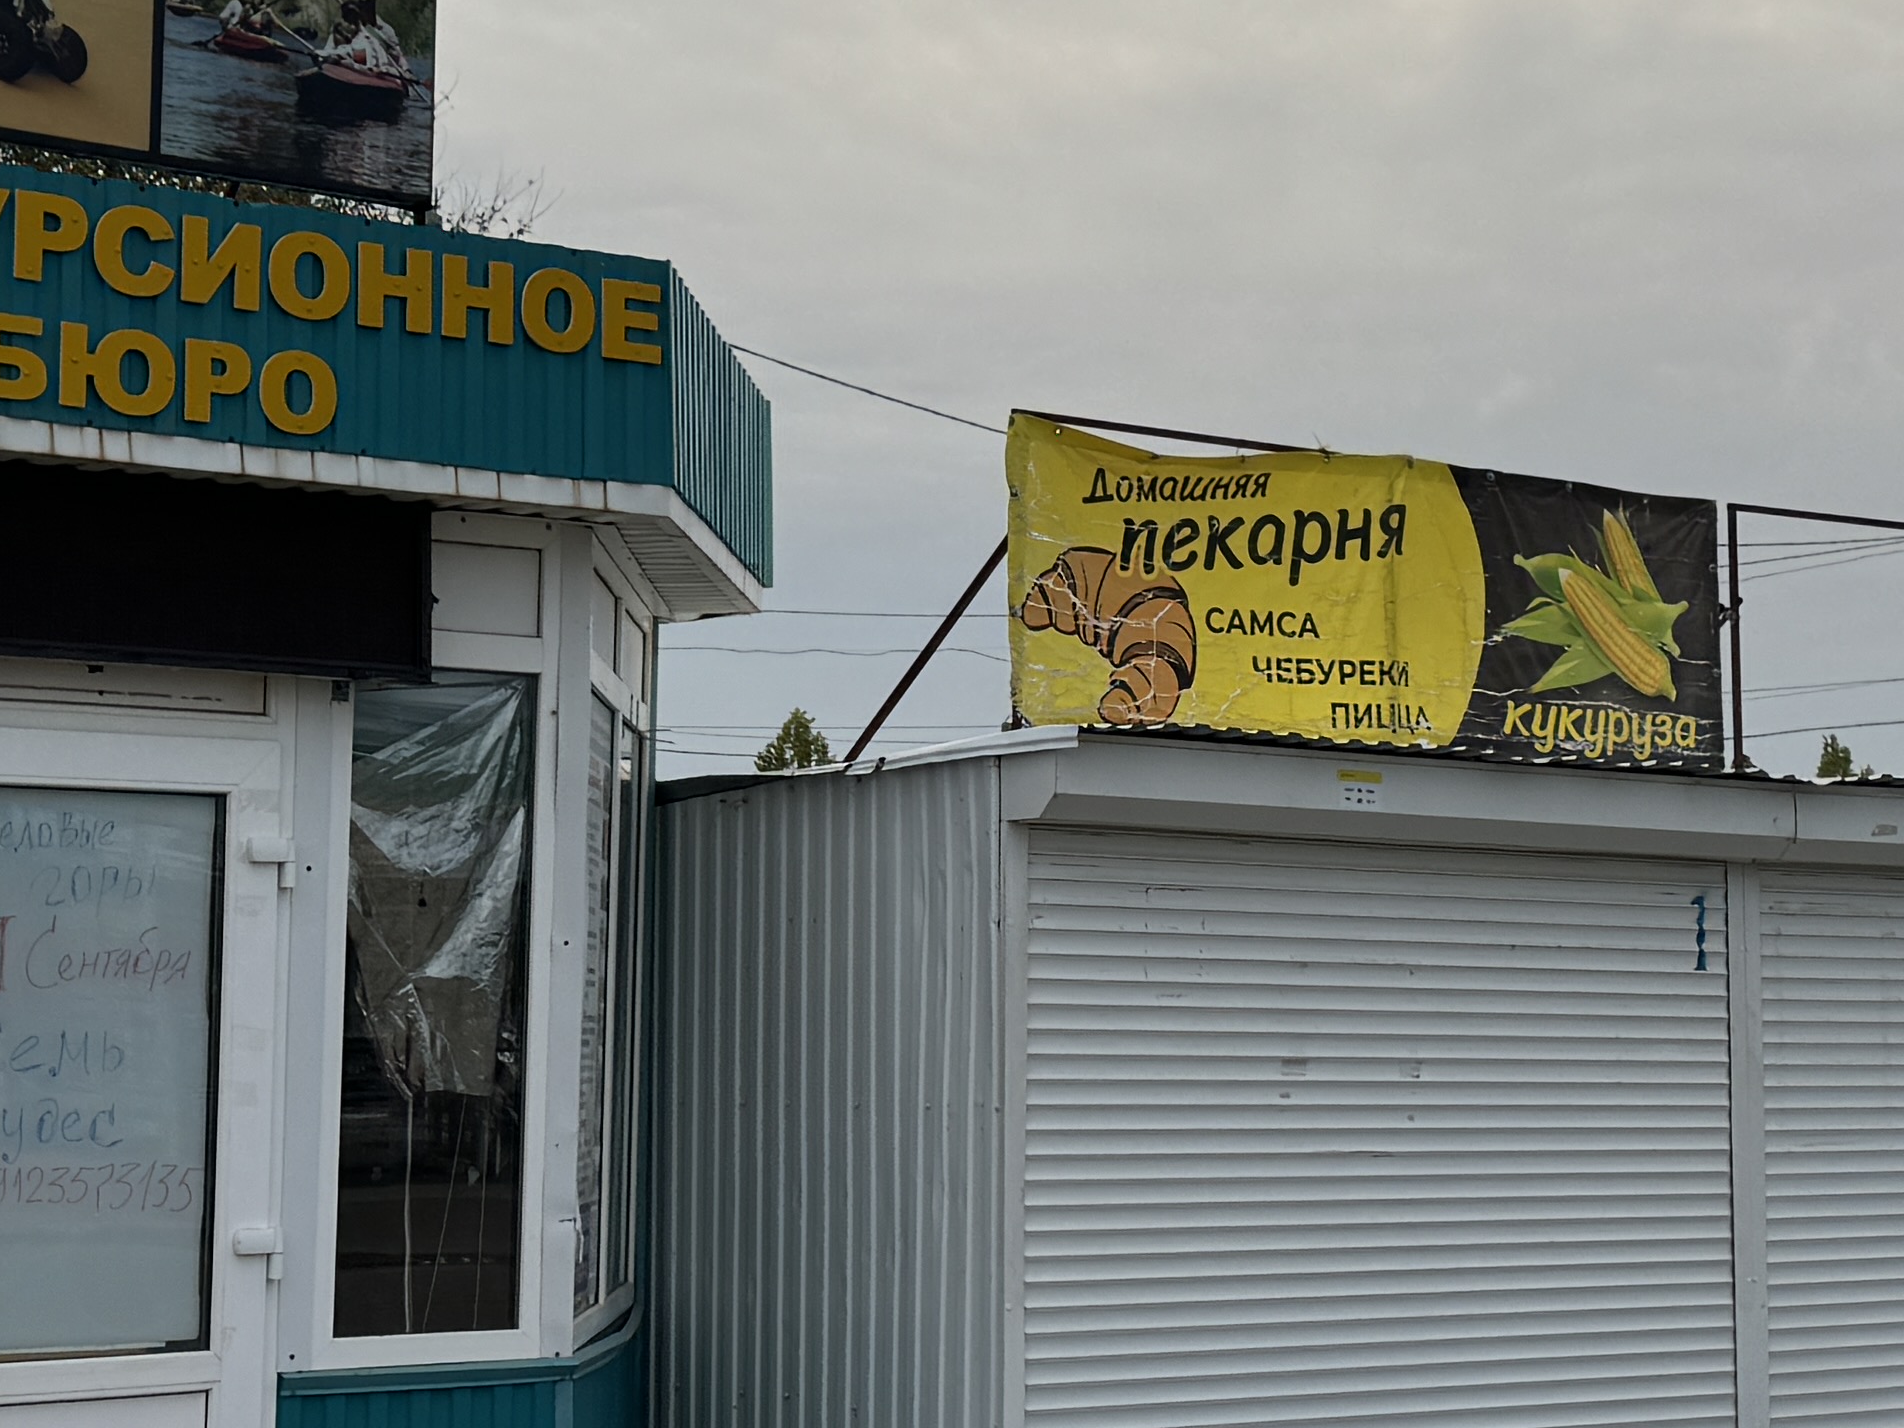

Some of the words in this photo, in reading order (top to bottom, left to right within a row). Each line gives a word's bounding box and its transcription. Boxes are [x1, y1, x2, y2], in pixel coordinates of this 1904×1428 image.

[1082, 467, 1272, 505] Домашняя
[1119, 503, 1408, 586] пекарня
[1205, 606, 1321, 640] САМСА
[1252, 656, 1410, 688] ЧЕБУРЕКИ
[1330, 701, 1431, 737] ПИЦЦА
[1504, 700, 1699, 760] кукуруза
[25, 914, 191, 992] Сентября
[1692, 895, 1709, 972] 1
